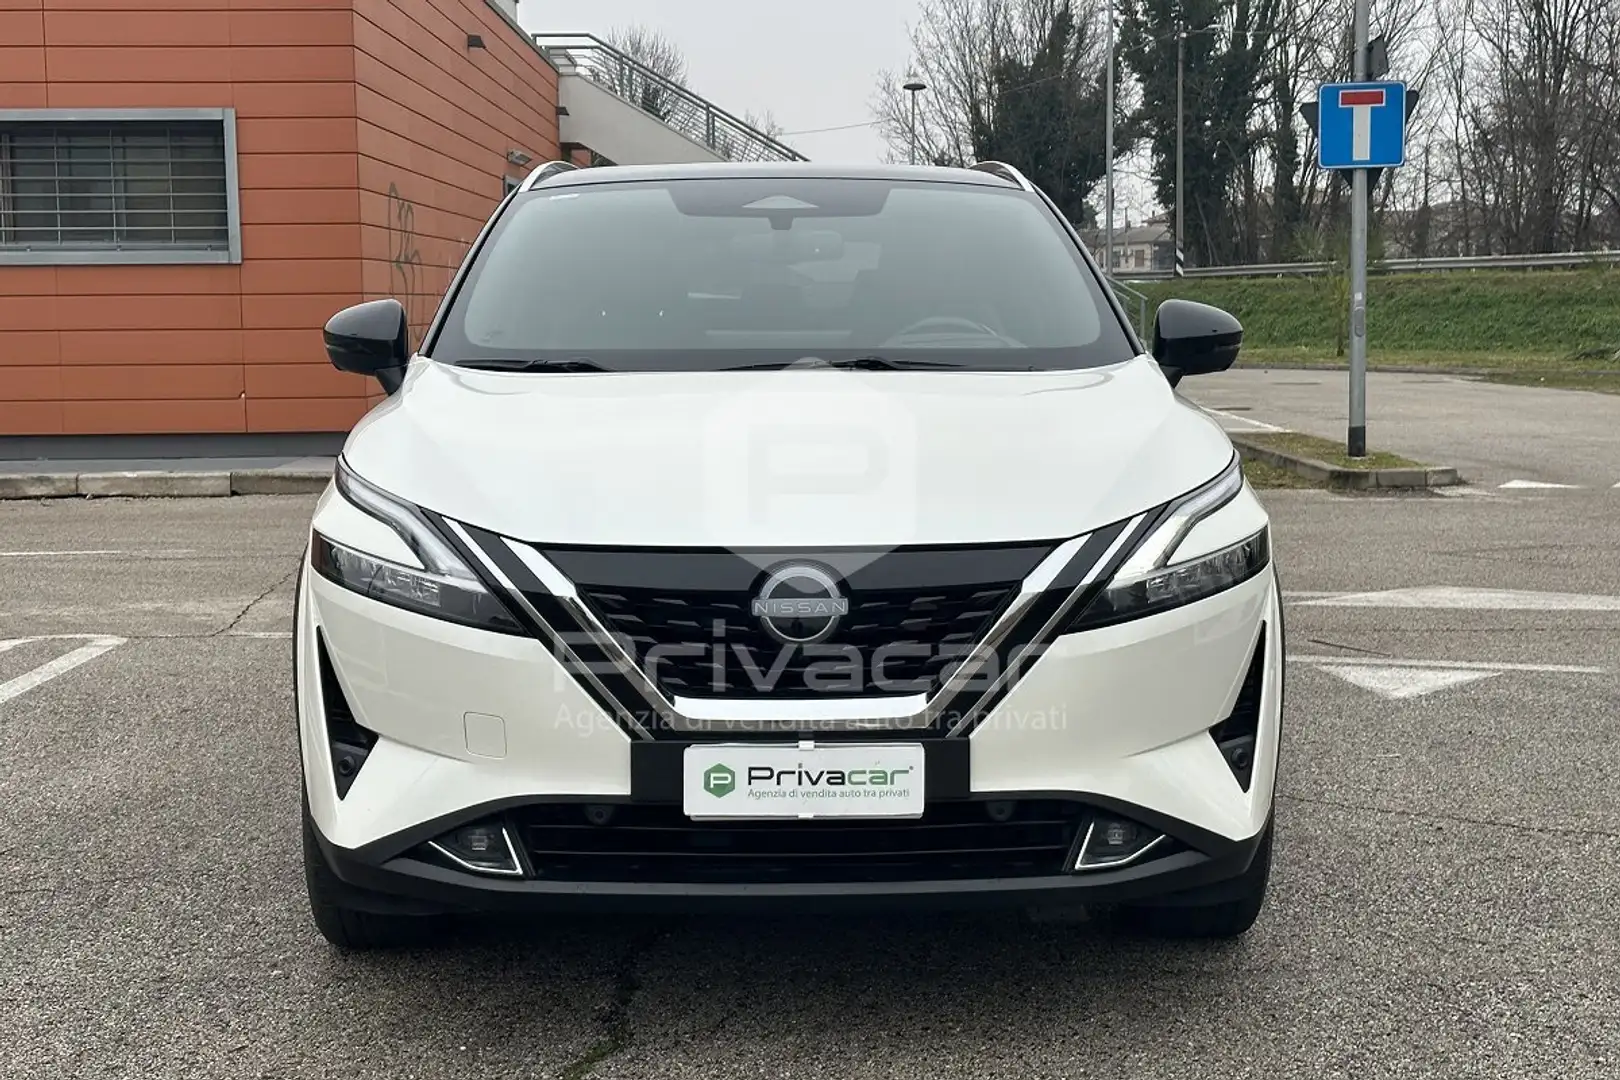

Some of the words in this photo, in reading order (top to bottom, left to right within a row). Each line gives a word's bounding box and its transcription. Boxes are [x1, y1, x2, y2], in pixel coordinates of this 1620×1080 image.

[753, 601, 846, 614] NISSAN
[709, 772, 732, 789] P
[747, 762, 911, 787] Privacar
[747, 788, 787, 800] Agenzia
[788, 788, 799, 799] di
[800, 788, 837, 799] vendita
[839, 789, 862, 799] auto
[863, 789, 877, 799] tra
[878, 788, 910, 800] privati
